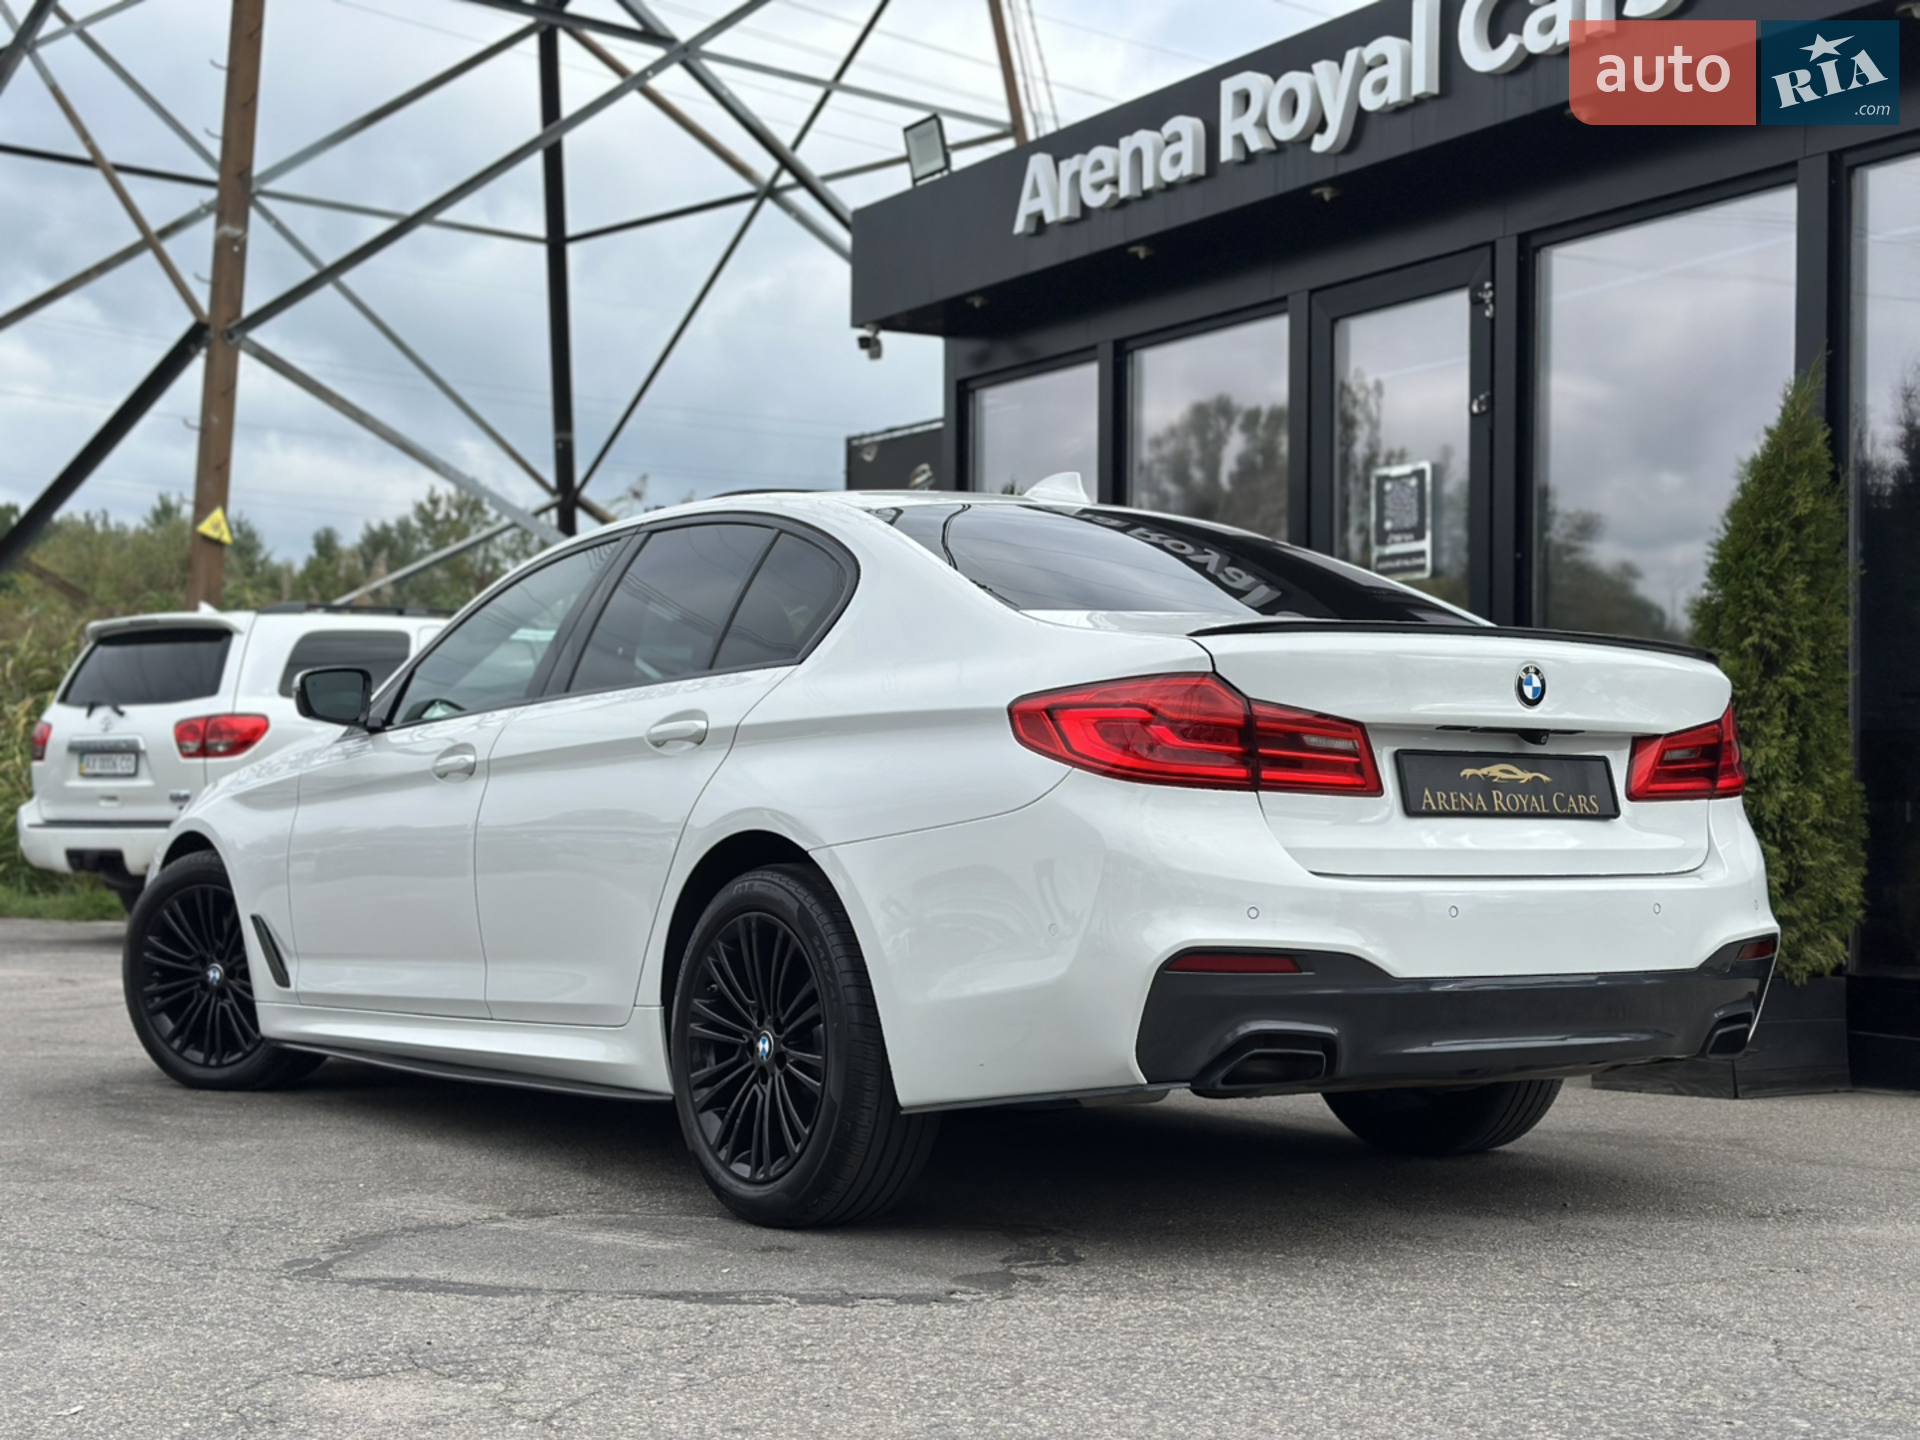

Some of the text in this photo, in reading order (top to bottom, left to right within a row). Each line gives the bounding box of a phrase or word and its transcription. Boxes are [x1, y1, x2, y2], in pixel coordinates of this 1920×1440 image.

[1013, 0, 1684, 235] Arena Royal Ca
[1421, 787, 1600, 815] ARENA ROYAL CARS
